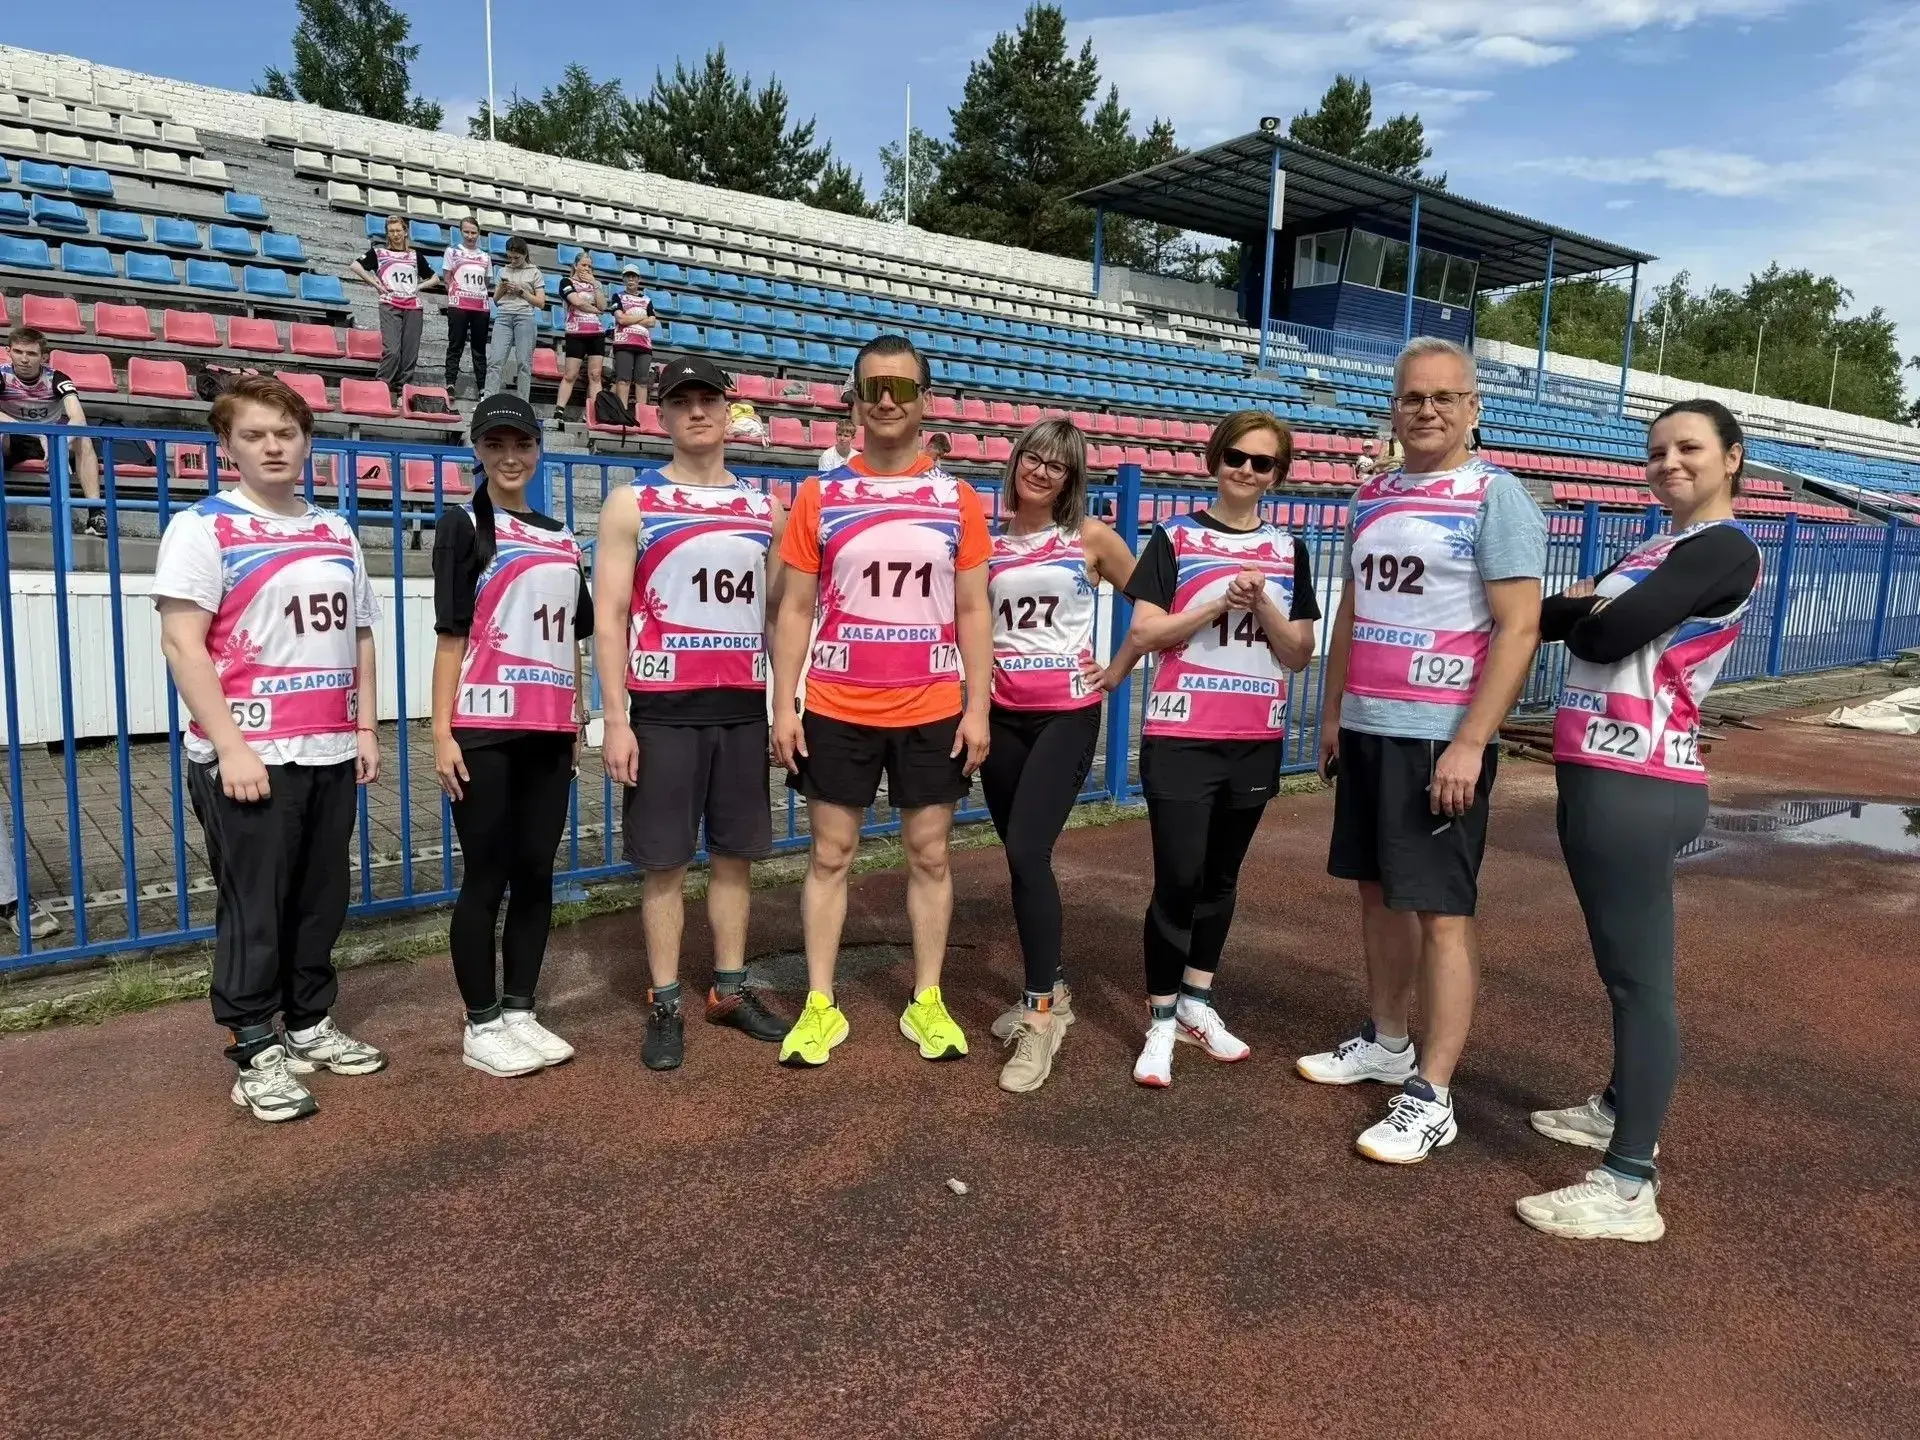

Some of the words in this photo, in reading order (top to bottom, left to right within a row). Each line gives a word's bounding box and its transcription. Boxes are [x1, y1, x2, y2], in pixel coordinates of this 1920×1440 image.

[392, 271, 413, 284] 121
[463, 273, 484, 285] 110
[691, 568, 755, 604] 164
[862, 560, 933, 598] 171
[1360, 553, 1425, 595] 192
[284, 591, 348, 636] 159
[533, 603, 576, 643] 11
[998, 595, 1060, 631] 127
[664, 635, 759, 650] ХАБАРОВСК
[841, 626, 938, 642] ХАБАРОВСК
[635, 653, 670, 679] 164
[818, 644, 848, 669] 171
[1003, 657, 1077, 671] БАРОВСК
[259, 672, 352, 694] ХАБАРОВСК
[504, 667, 574, 688] ХАБАОВС
[1412, 654, 1465, 686] 192
[463, 687, 509, 714] 111
[1151, 694, 1187, 719] 144
[230, 701, 266, 729] 59
[1271, 702, 1287, 726] 14
[1587, 720, 1640, 757] 122
